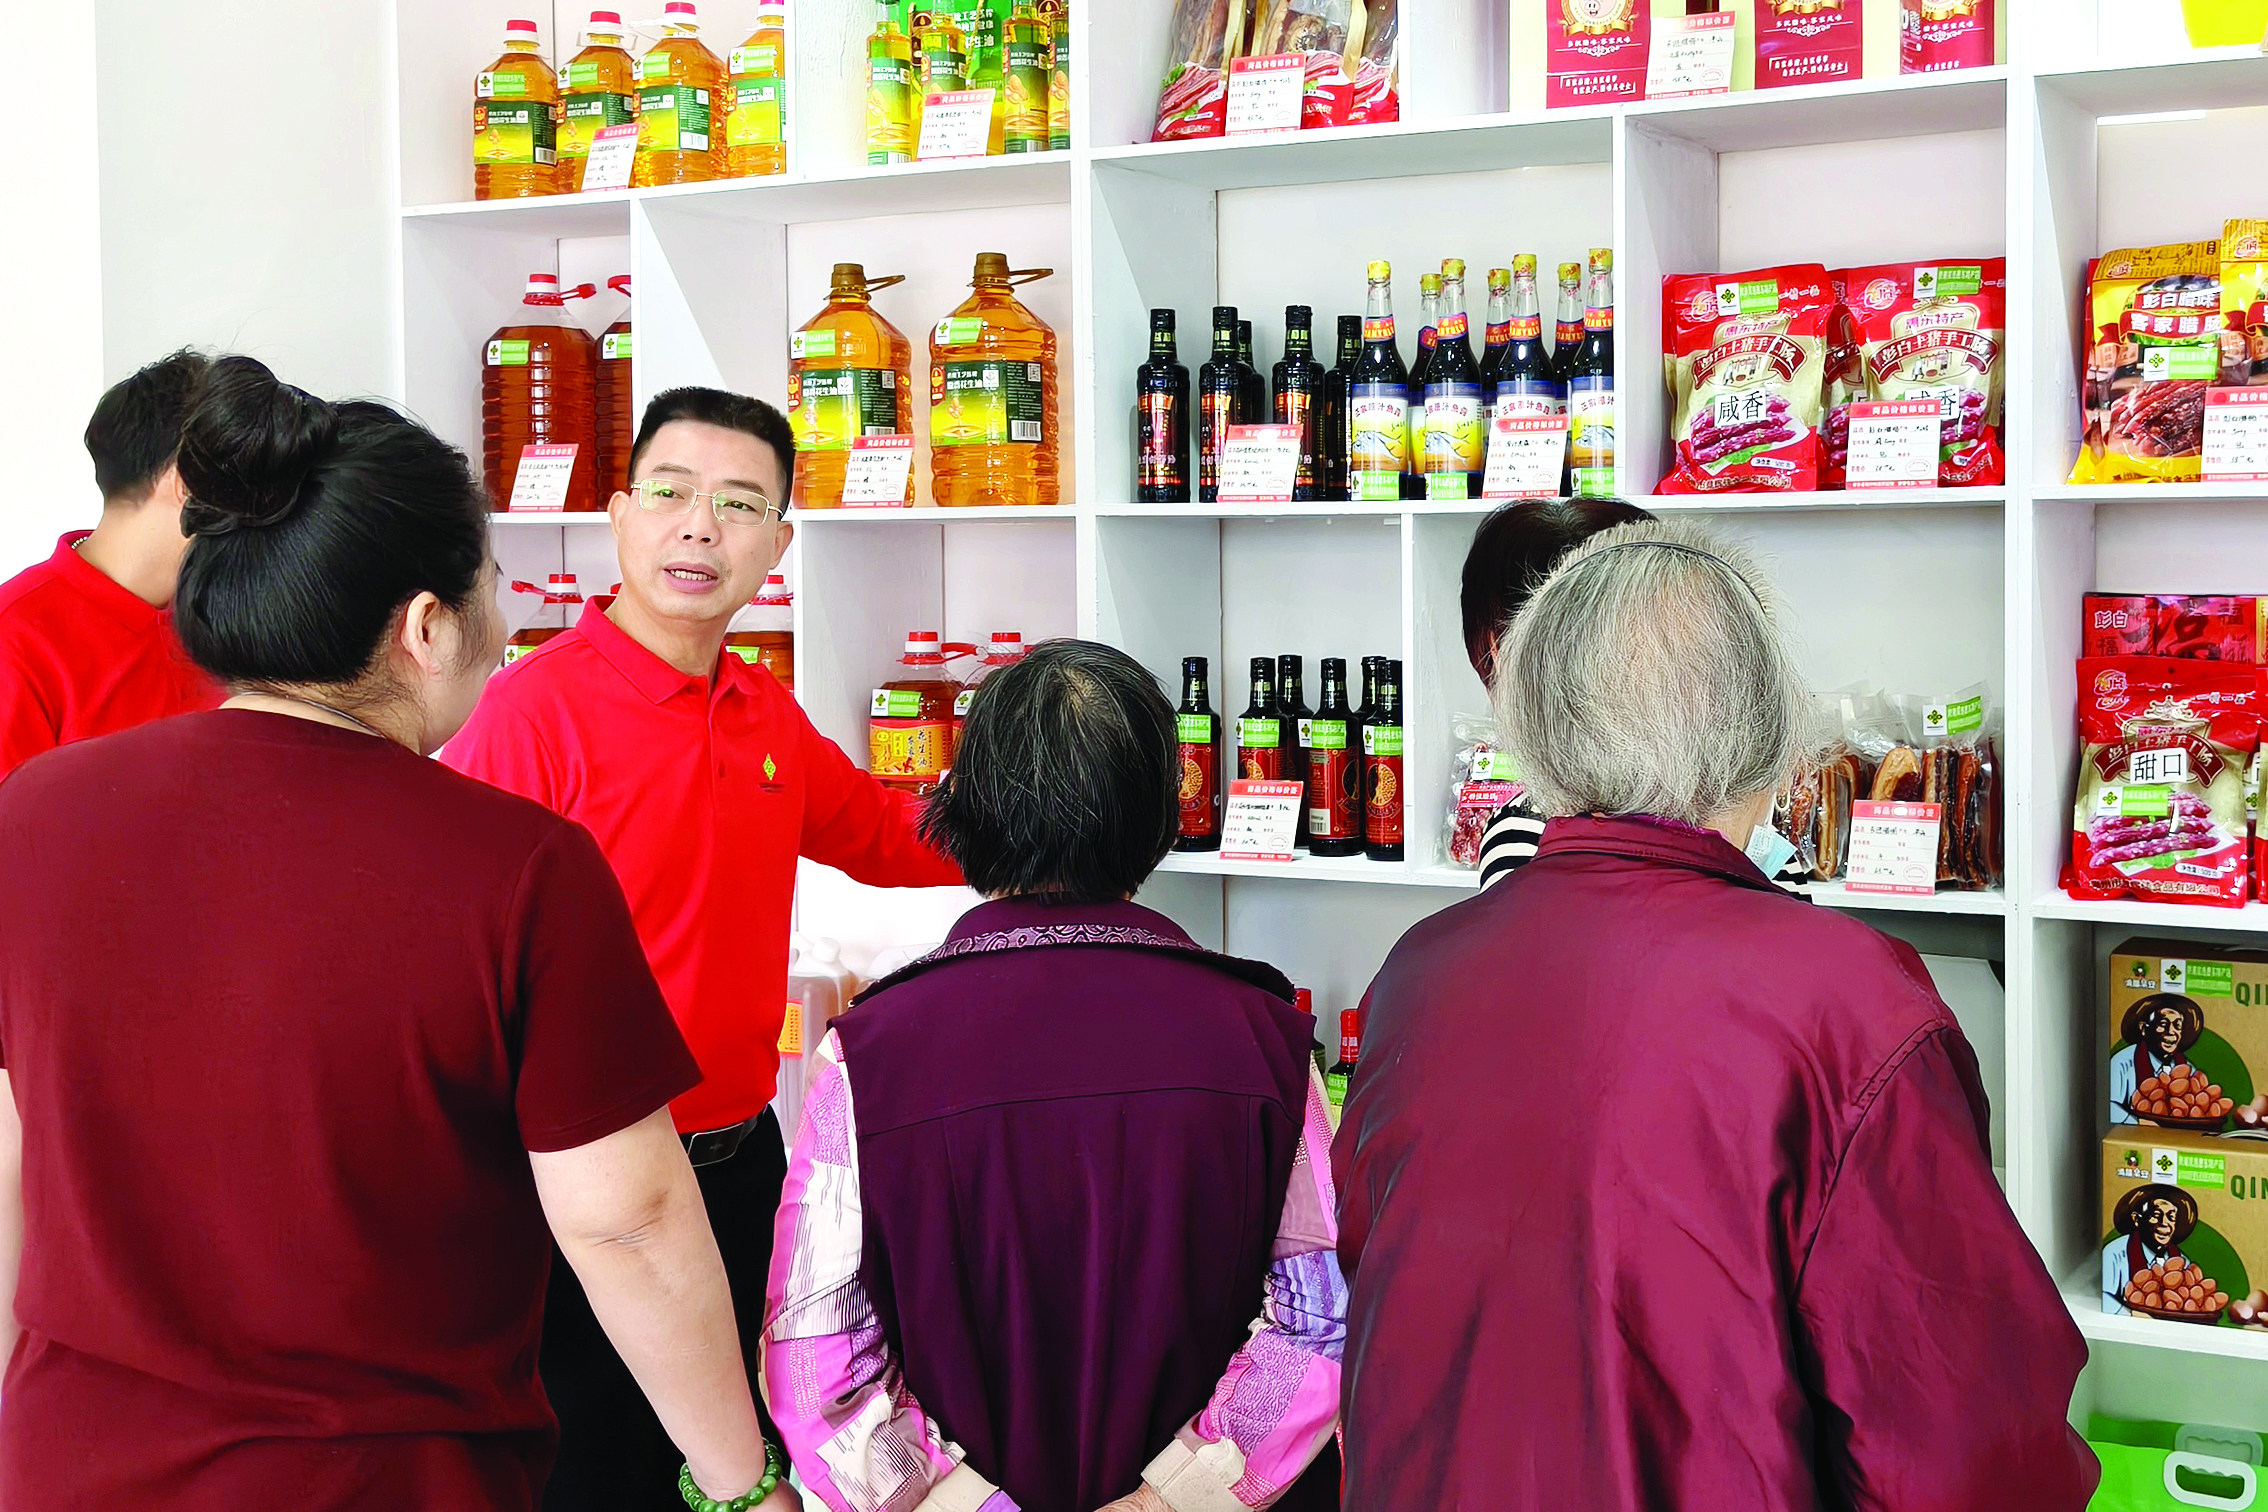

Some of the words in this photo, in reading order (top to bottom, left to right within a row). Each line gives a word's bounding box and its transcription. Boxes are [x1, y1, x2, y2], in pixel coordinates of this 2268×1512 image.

[2141, 291, 2216, 309] 彭白腊味
[2130, 313, 2221, 334] 客家腊肠
[1716, 390, 1764, 424] 咸香
[1911, 388, 1957, 416] 香
[2095, 611, 2128, 629] 彭白
[2134, 752, 2183, 782] 甜口
[1873, 806, 1935, 818] 商品标价签
